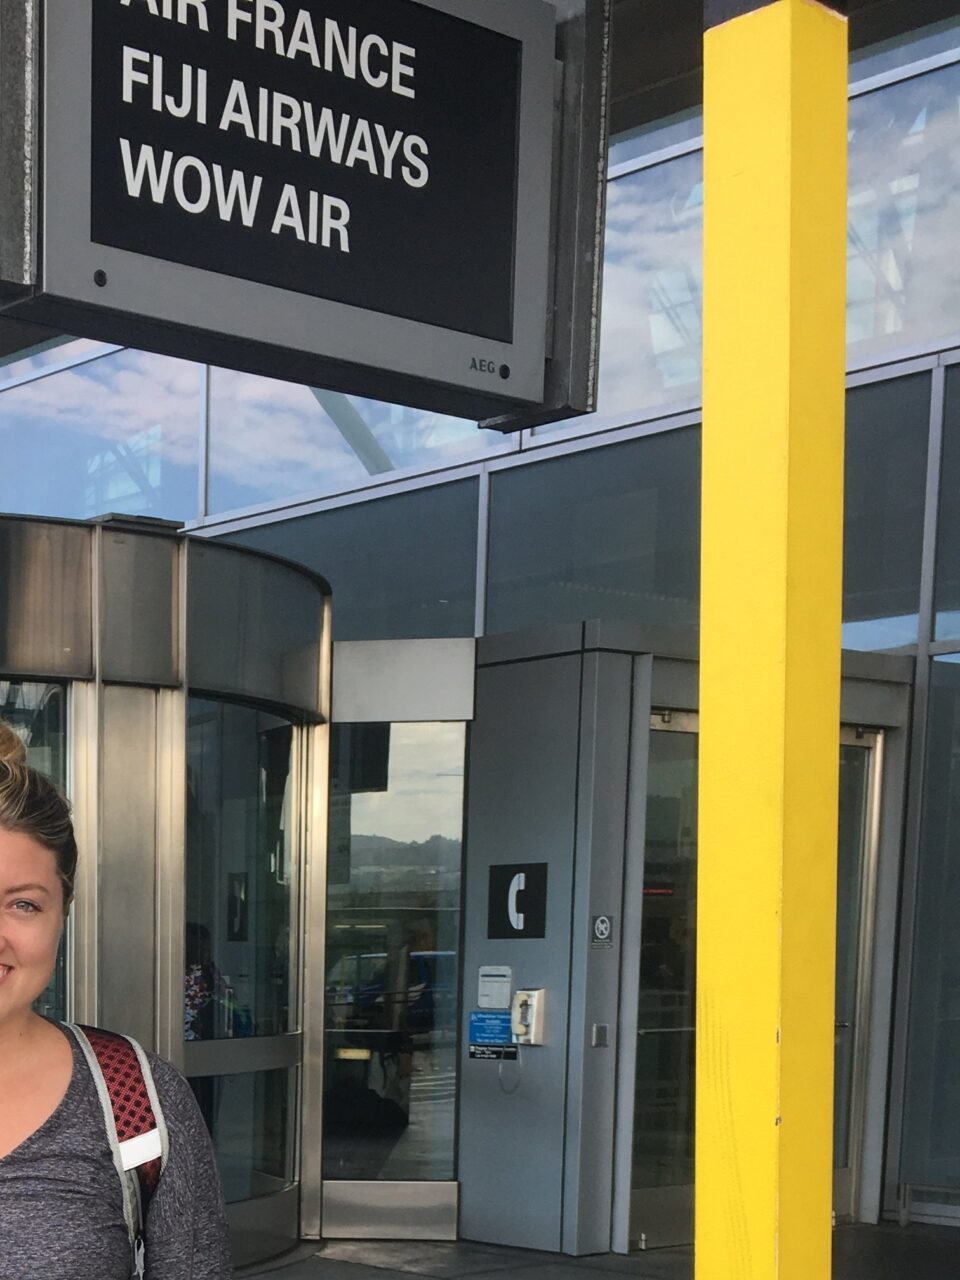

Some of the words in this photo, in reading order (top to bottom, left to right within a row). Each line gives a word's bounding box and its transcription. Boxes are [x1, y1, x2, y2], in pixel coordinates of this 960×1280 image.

[227, 0, 416, 99] FRANCE
[122, 45, 208, 124] FIJI
[219, 79, 430, 188] AIRWAYS
[119, 138, 263, 228] WOW
[272, 184, 351, 252] AIR
[470, 357, 496, 373] AEG
